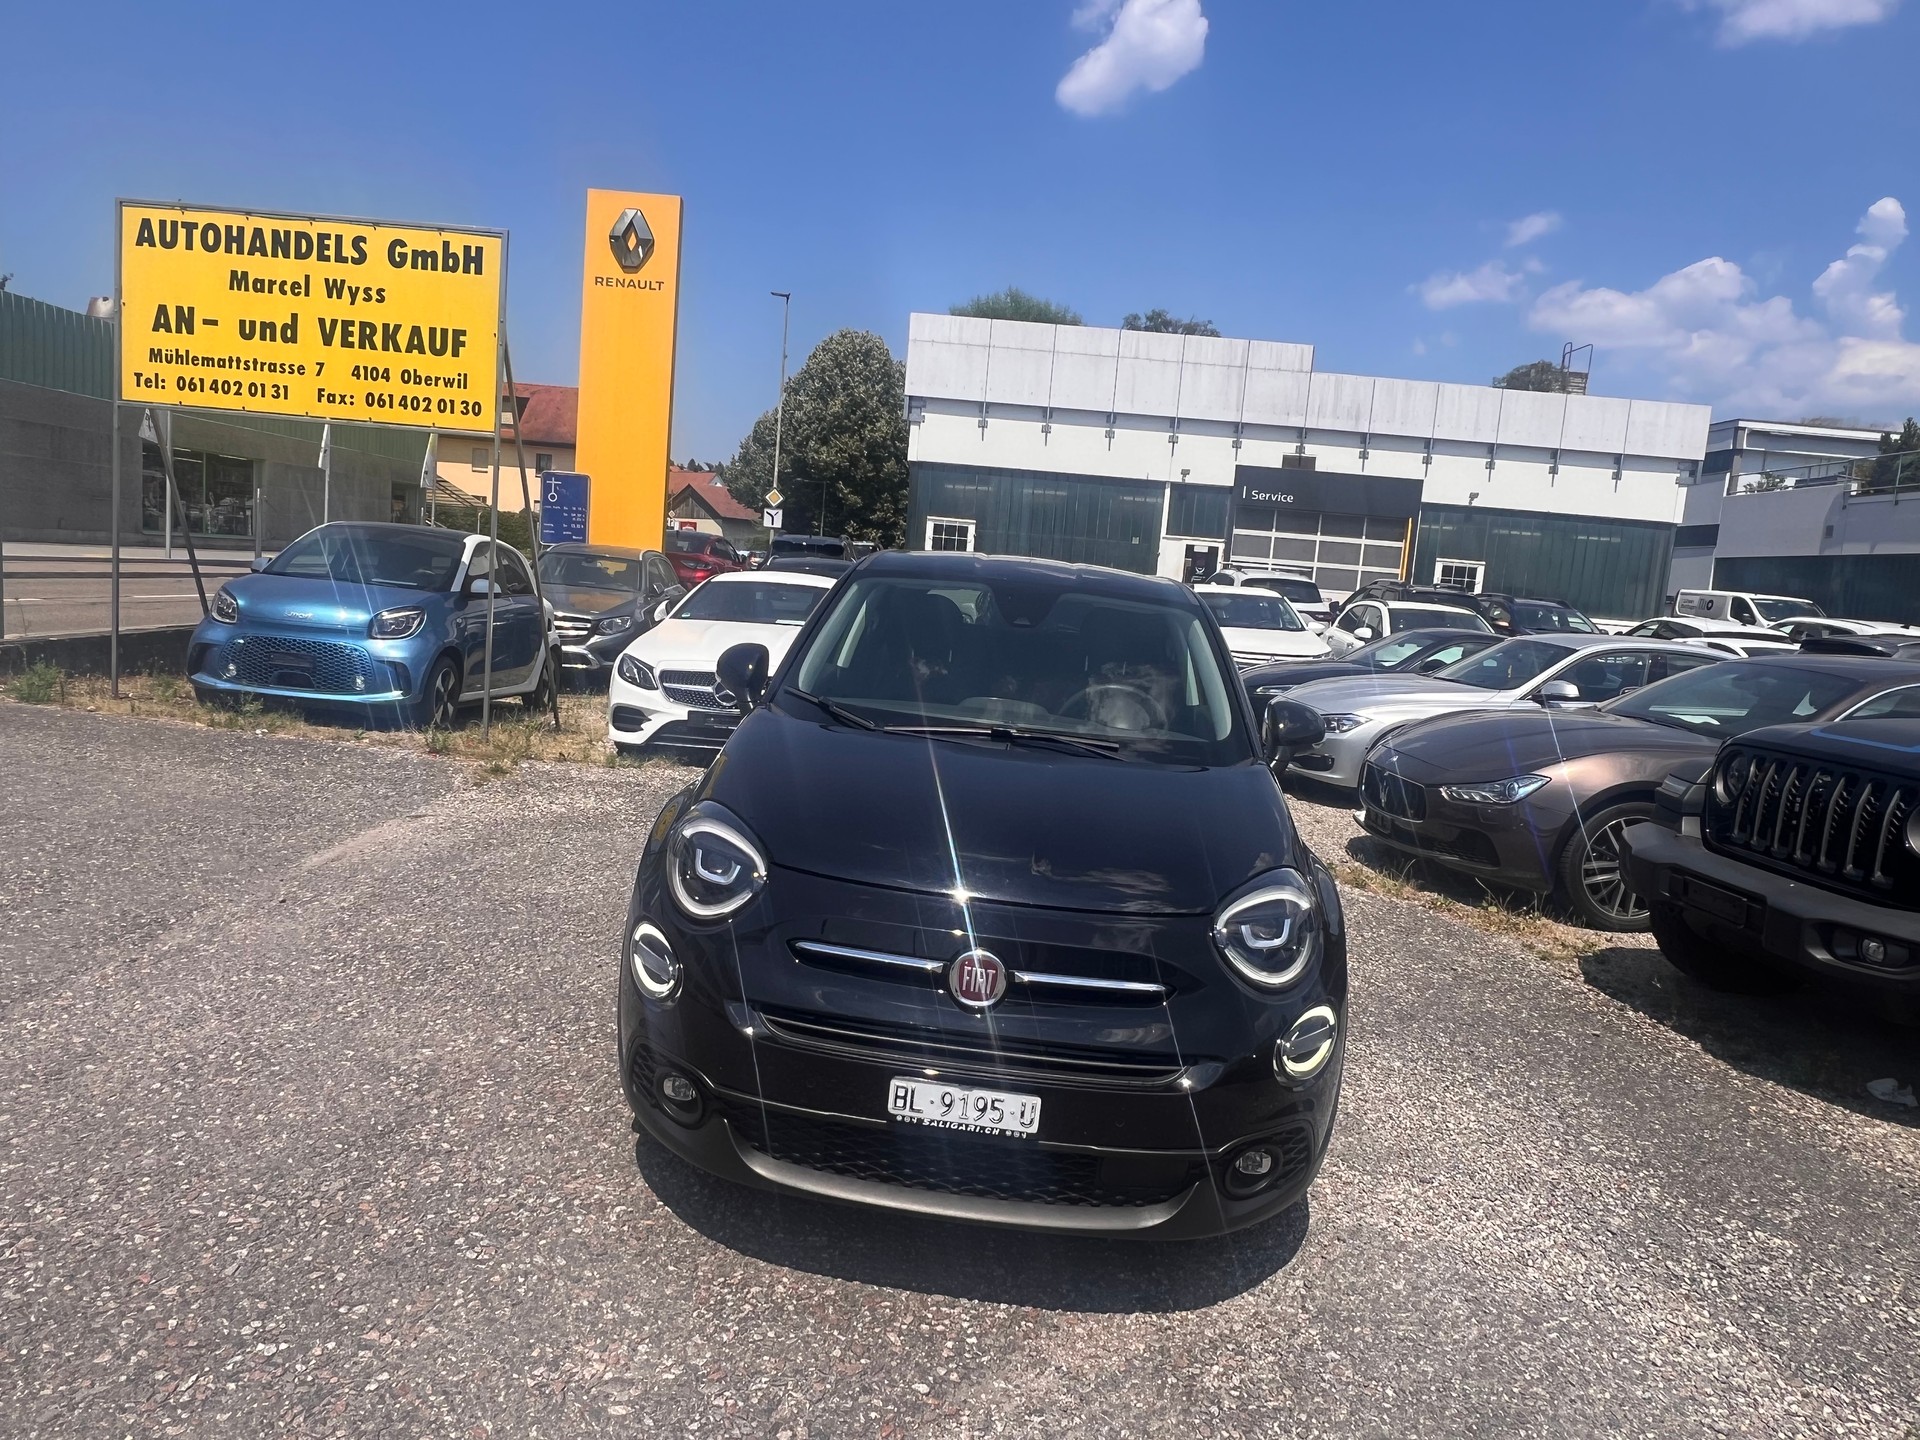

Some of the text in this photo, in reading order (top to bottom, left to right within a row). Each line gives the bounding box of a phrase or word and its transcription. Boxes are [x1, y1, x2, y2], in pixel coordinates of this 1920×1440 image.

[136, 217, 484, 276] AUTOHANDELS GmbH
[229, 269, 386, 306] Marcel Wyss
[594, 276, 665, 291] RENAULT
[238, 312, 299, 345] und
[317, 317, 467, 358] VERKAUF
[133, 372, 166, 390] Tel:
[148, 347, 468, 390] Mühlemattstrasse 7 4104 Oberwil
[317, 387, 355, 406] Fax:
[1251, 489, 1294, 503] Service
[962, 964, 997, 994] FIAT
[892, 1082, 1037, 1128] BL 9195 U
